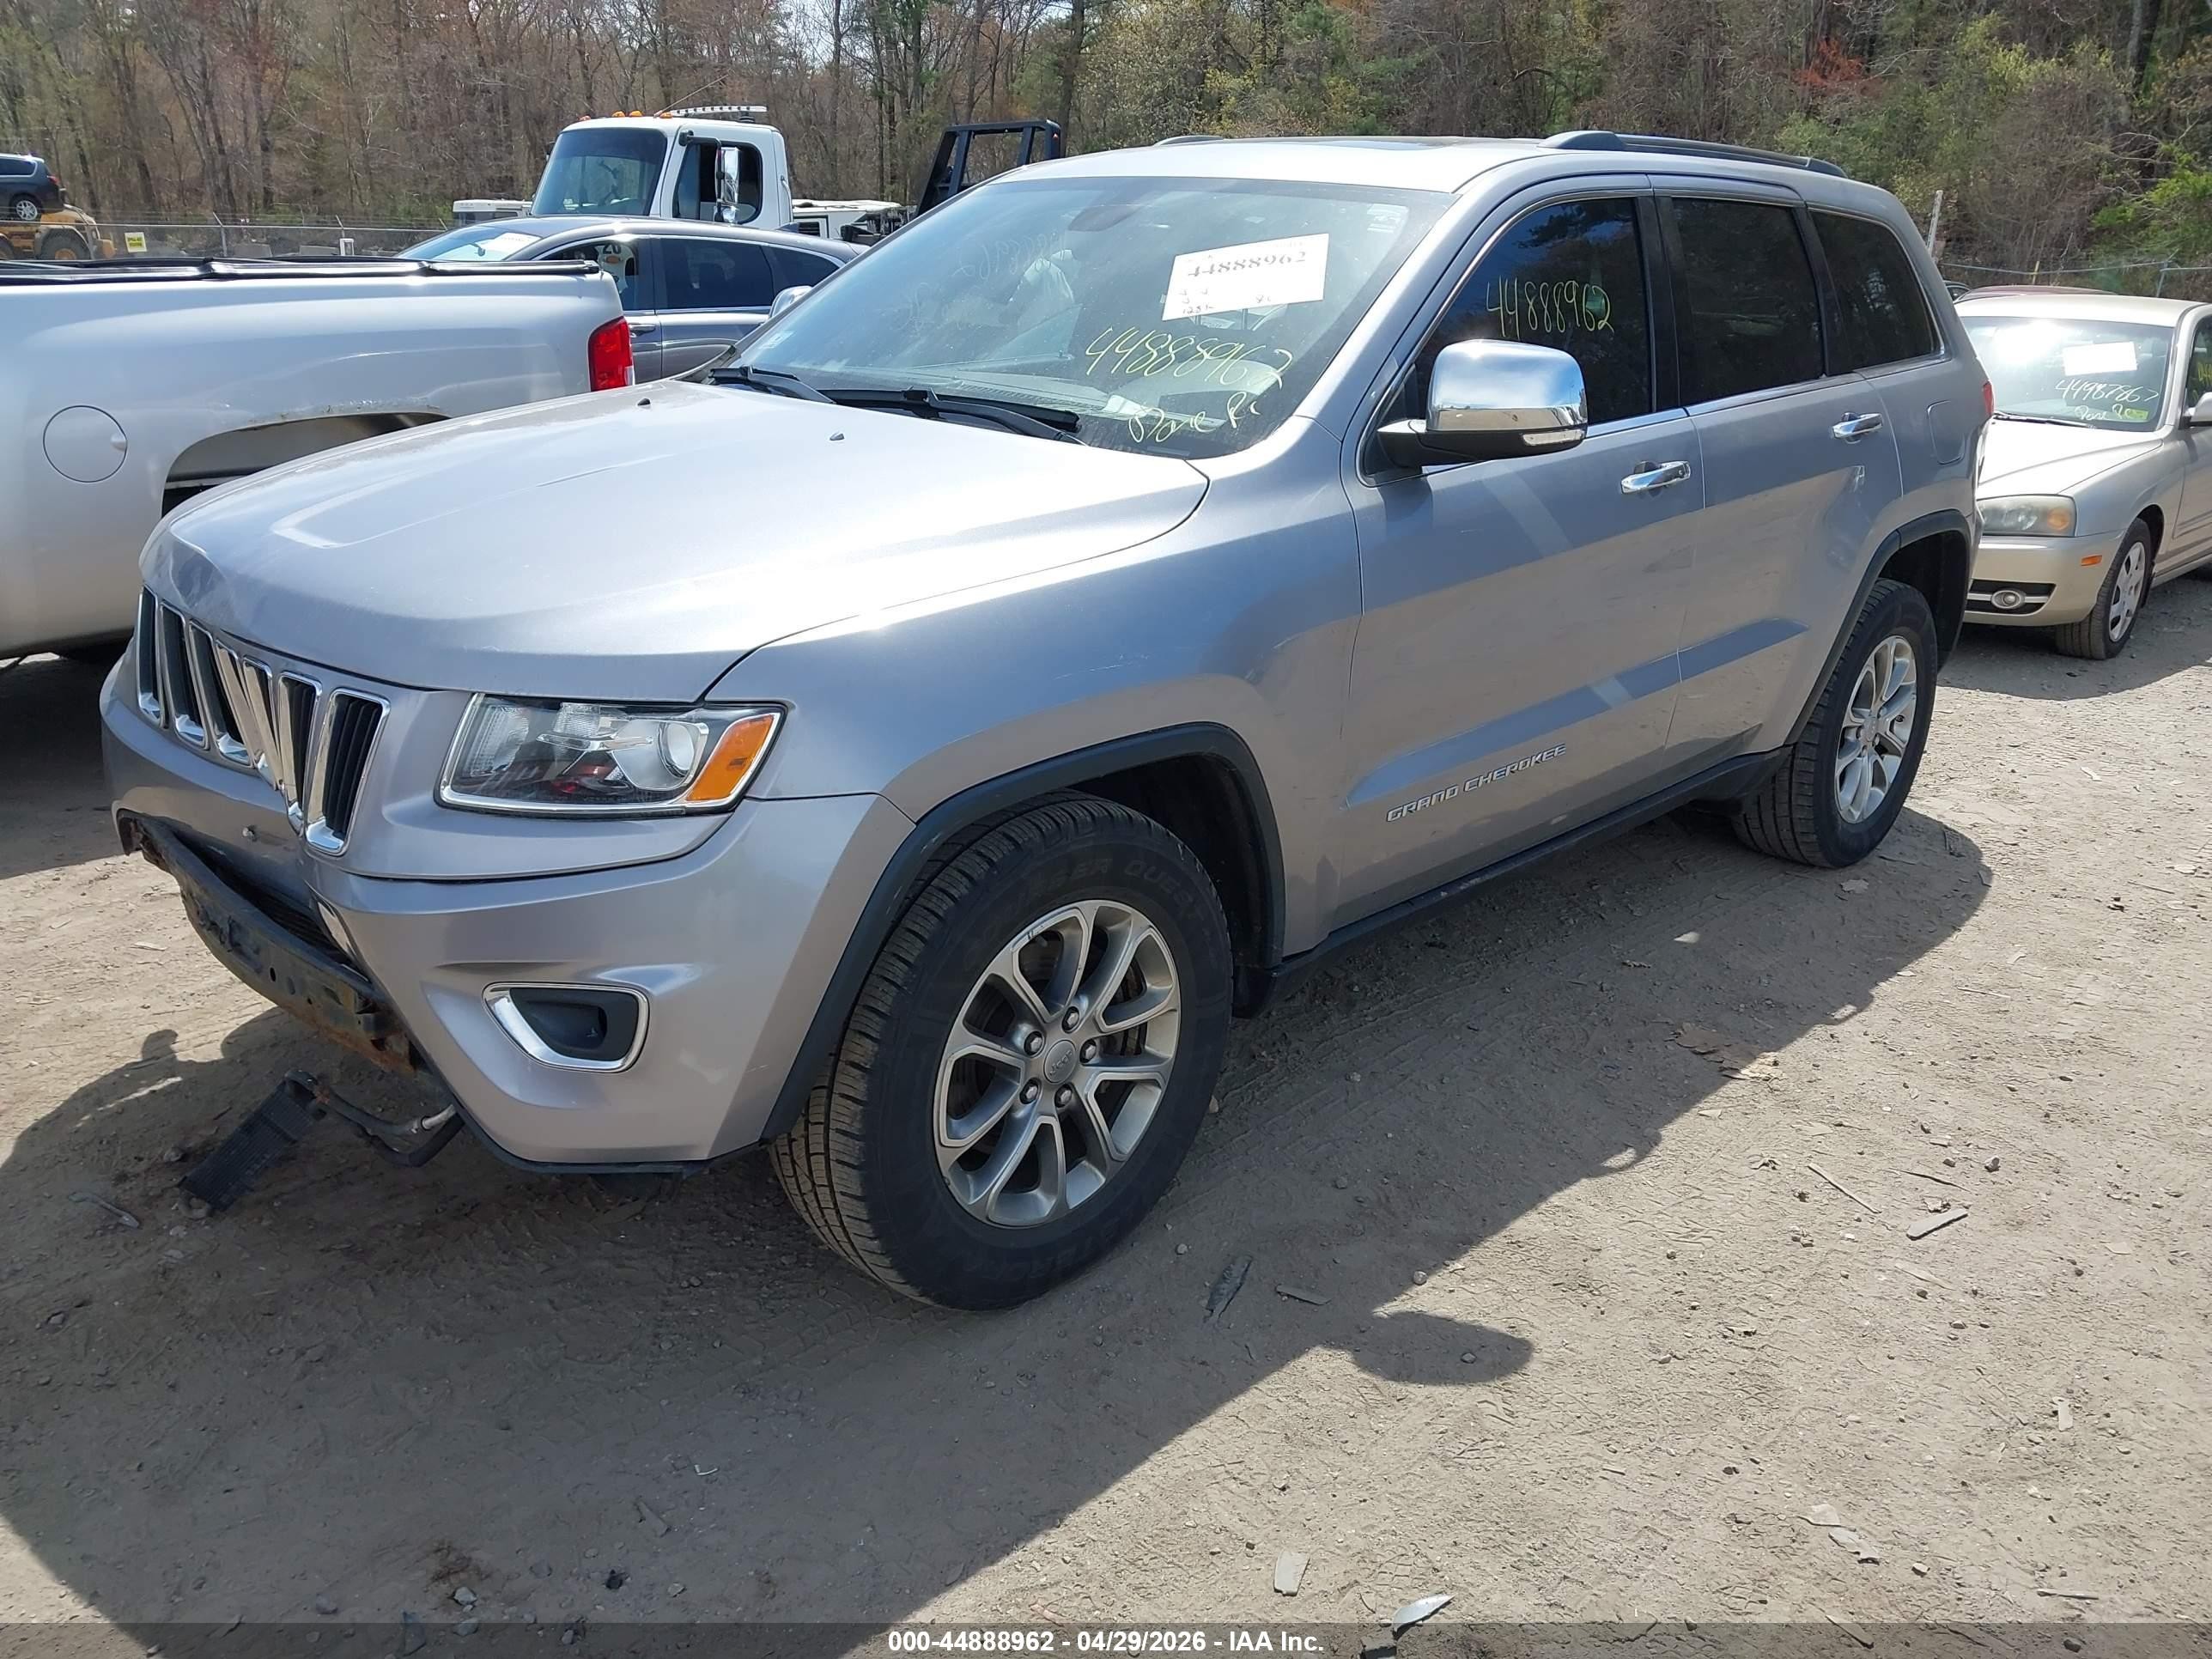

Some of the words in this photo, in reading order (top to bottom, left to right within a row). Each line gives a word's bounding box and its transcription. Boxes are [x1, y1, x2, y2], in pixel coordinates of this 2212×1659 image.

[1486, 275, 1614, 340] 44888962
[1085, 326, 1292, 389] 44888962
[1386, 783, 1460, 823] GRAND
[1462, 743, 1567, 792] CHEROKEE
[1048, 1050, 1073, 1075] Jeep
